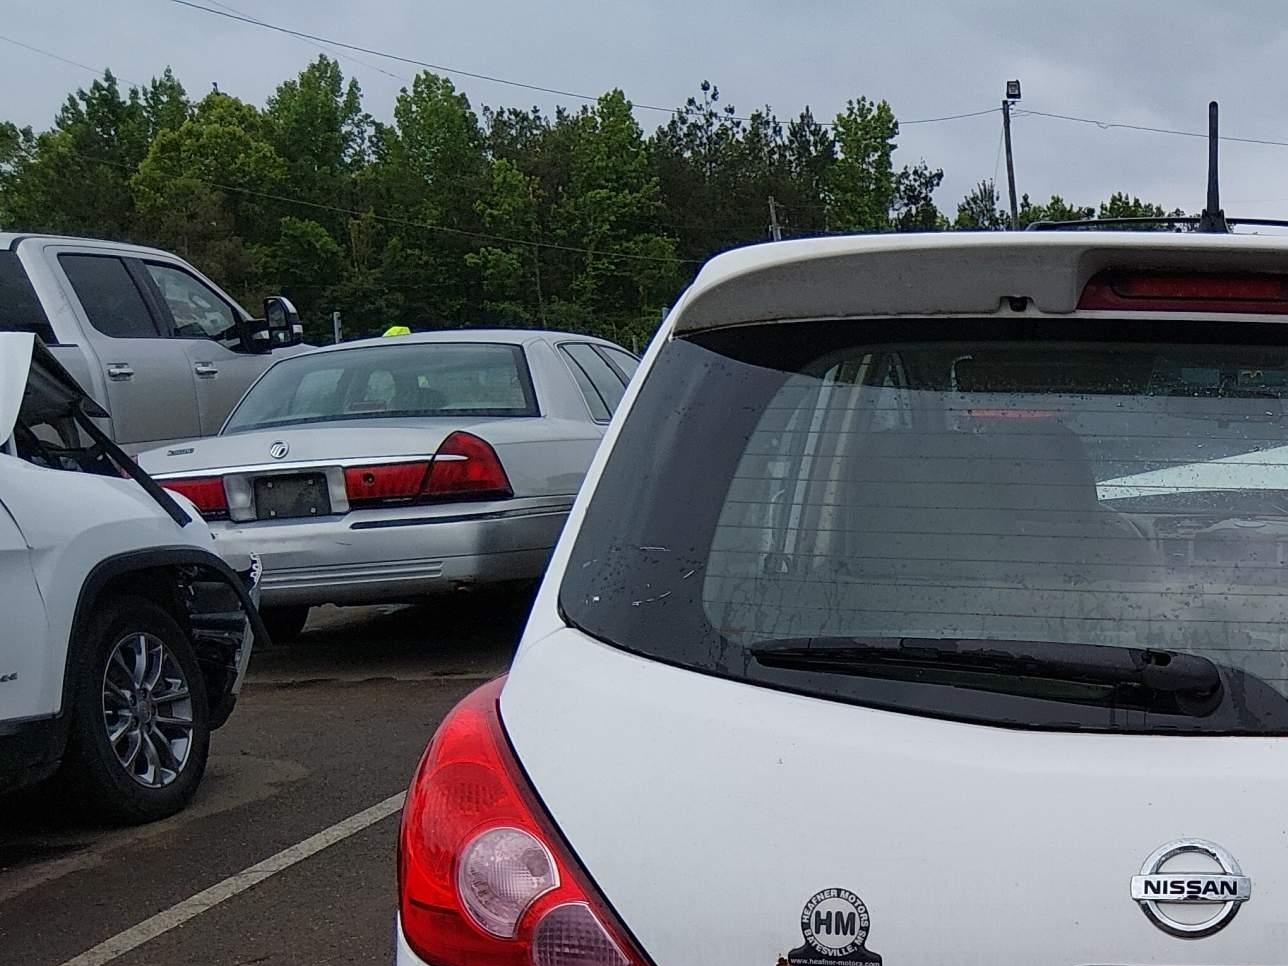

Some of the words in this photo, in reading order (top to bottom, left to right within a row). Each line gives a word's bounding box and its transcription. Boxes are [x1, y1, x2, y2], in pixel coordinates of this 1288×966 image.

[1144, 880, 1238, 896] NISSAN
[802, 889, 838, 923] HEAFNER
[839, 890, 869, 928] MOTORS
[814, 910, 856, 936] HM
[803, 928, 858, 957] BATESVILLE,
[855, 929, 867, 947] MS
